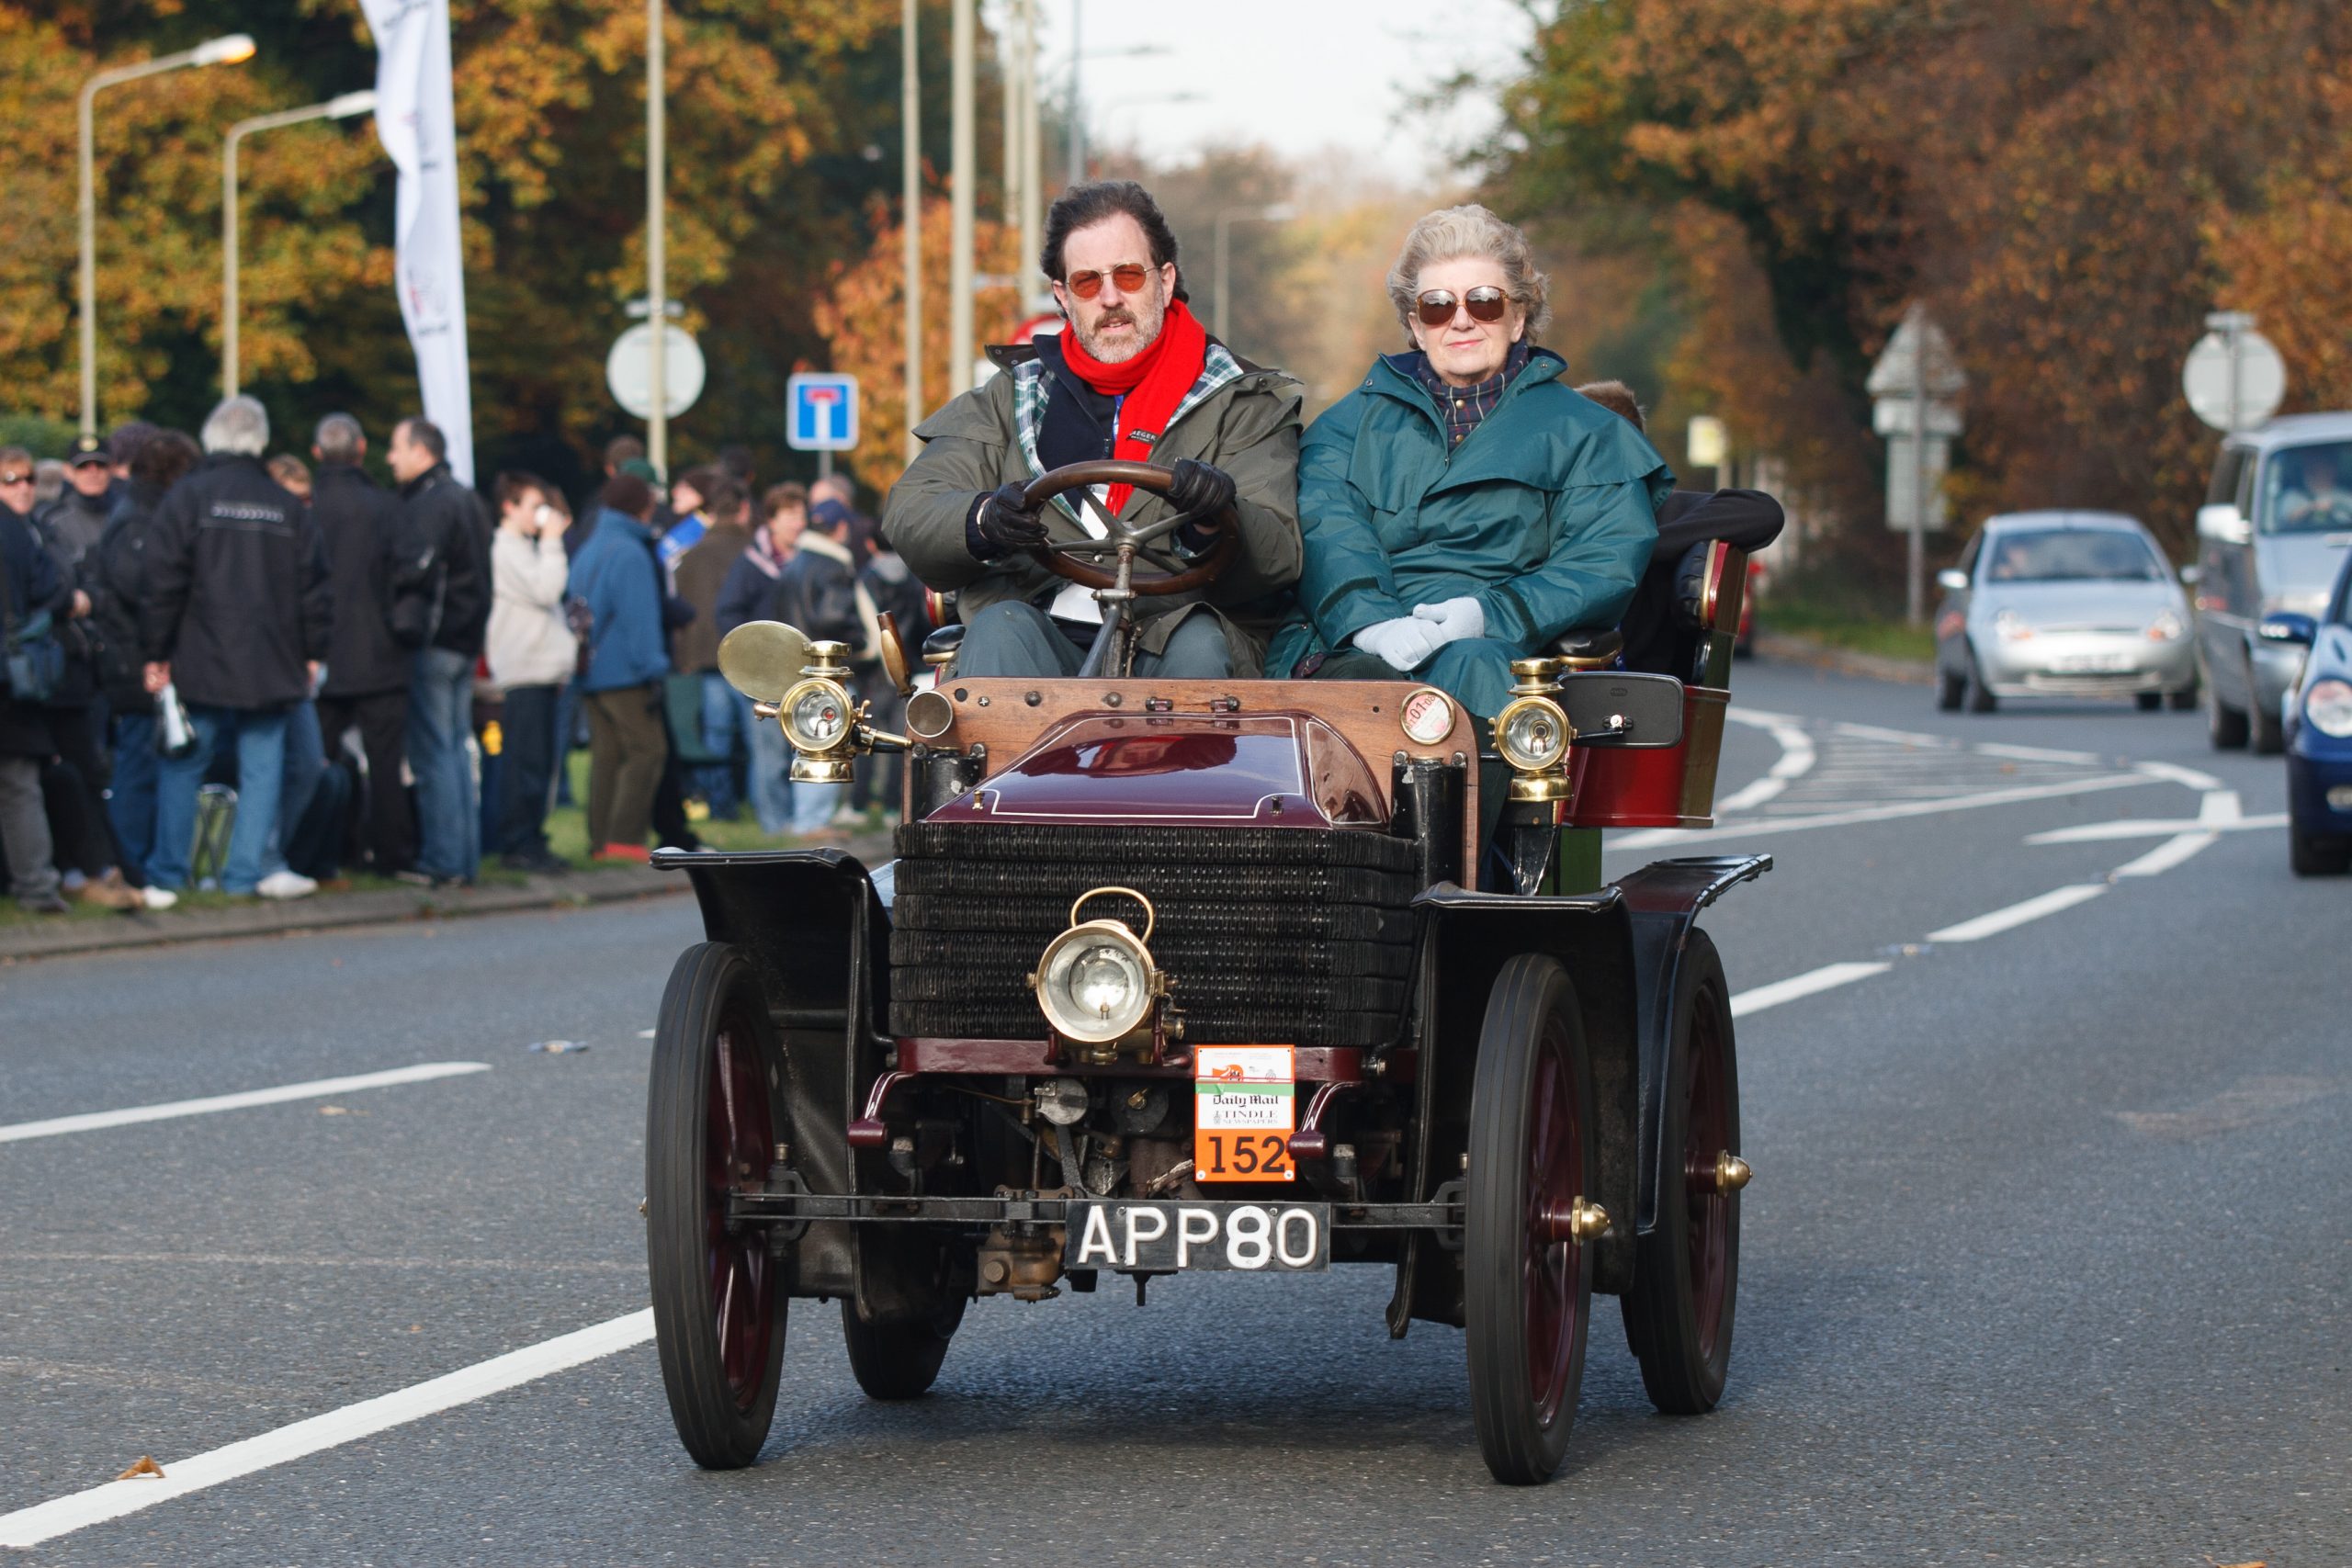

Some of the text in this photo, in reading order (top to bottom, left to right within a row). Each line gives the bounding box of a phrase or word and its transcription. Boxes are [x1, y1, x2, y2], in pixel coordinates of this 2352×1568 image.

[1409, 702, 1427, 719] 01
[1213, 1094, 1279, 1108] Daily Mail
[1223, 1110, 1278, 1119] TINDLE
[1208, 1135, 1286, 1174] 152
